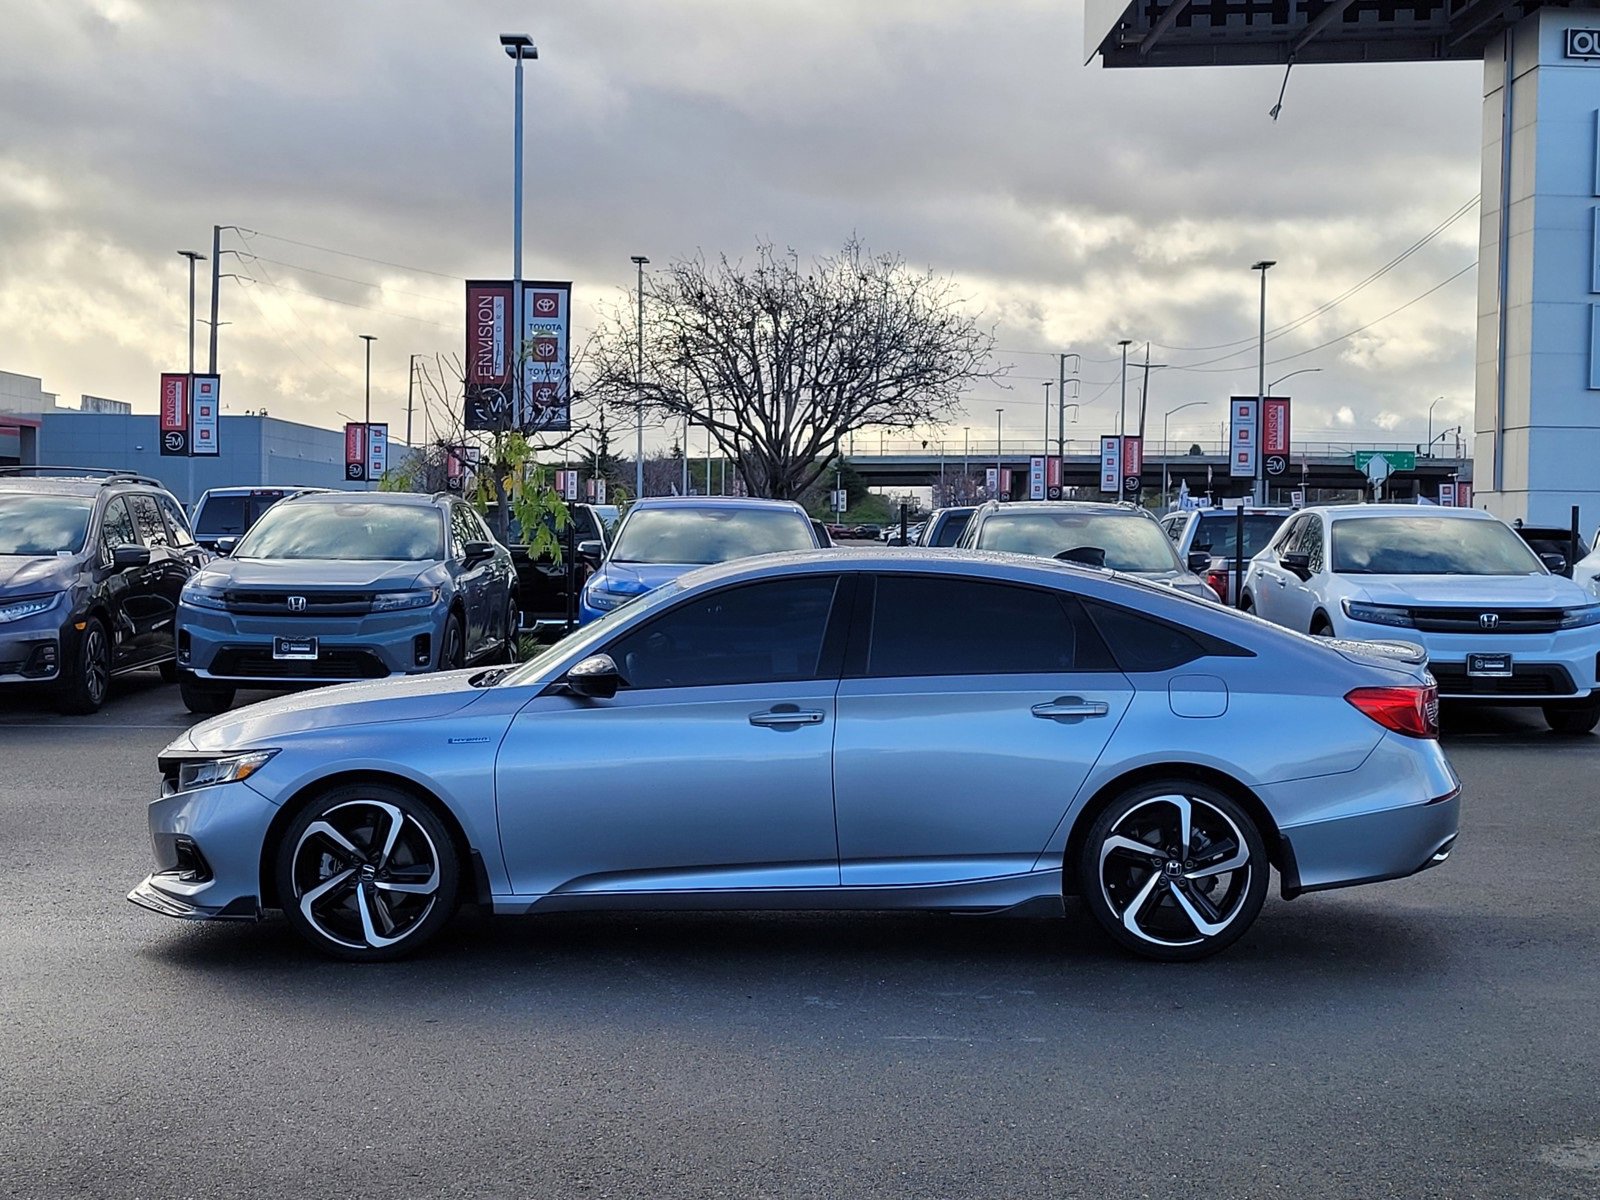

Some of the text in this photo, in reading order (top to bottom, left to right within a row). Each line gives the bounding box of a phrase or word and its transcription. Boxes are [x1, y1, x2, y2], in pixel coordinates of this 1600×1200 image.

[478, 296, 492, 376] ENVISION
[529, 323, 562, 331] TOYOTA
[166, 381, 176, 426] ENVISION
[1268, 404, 1277, 451] ENVISION
